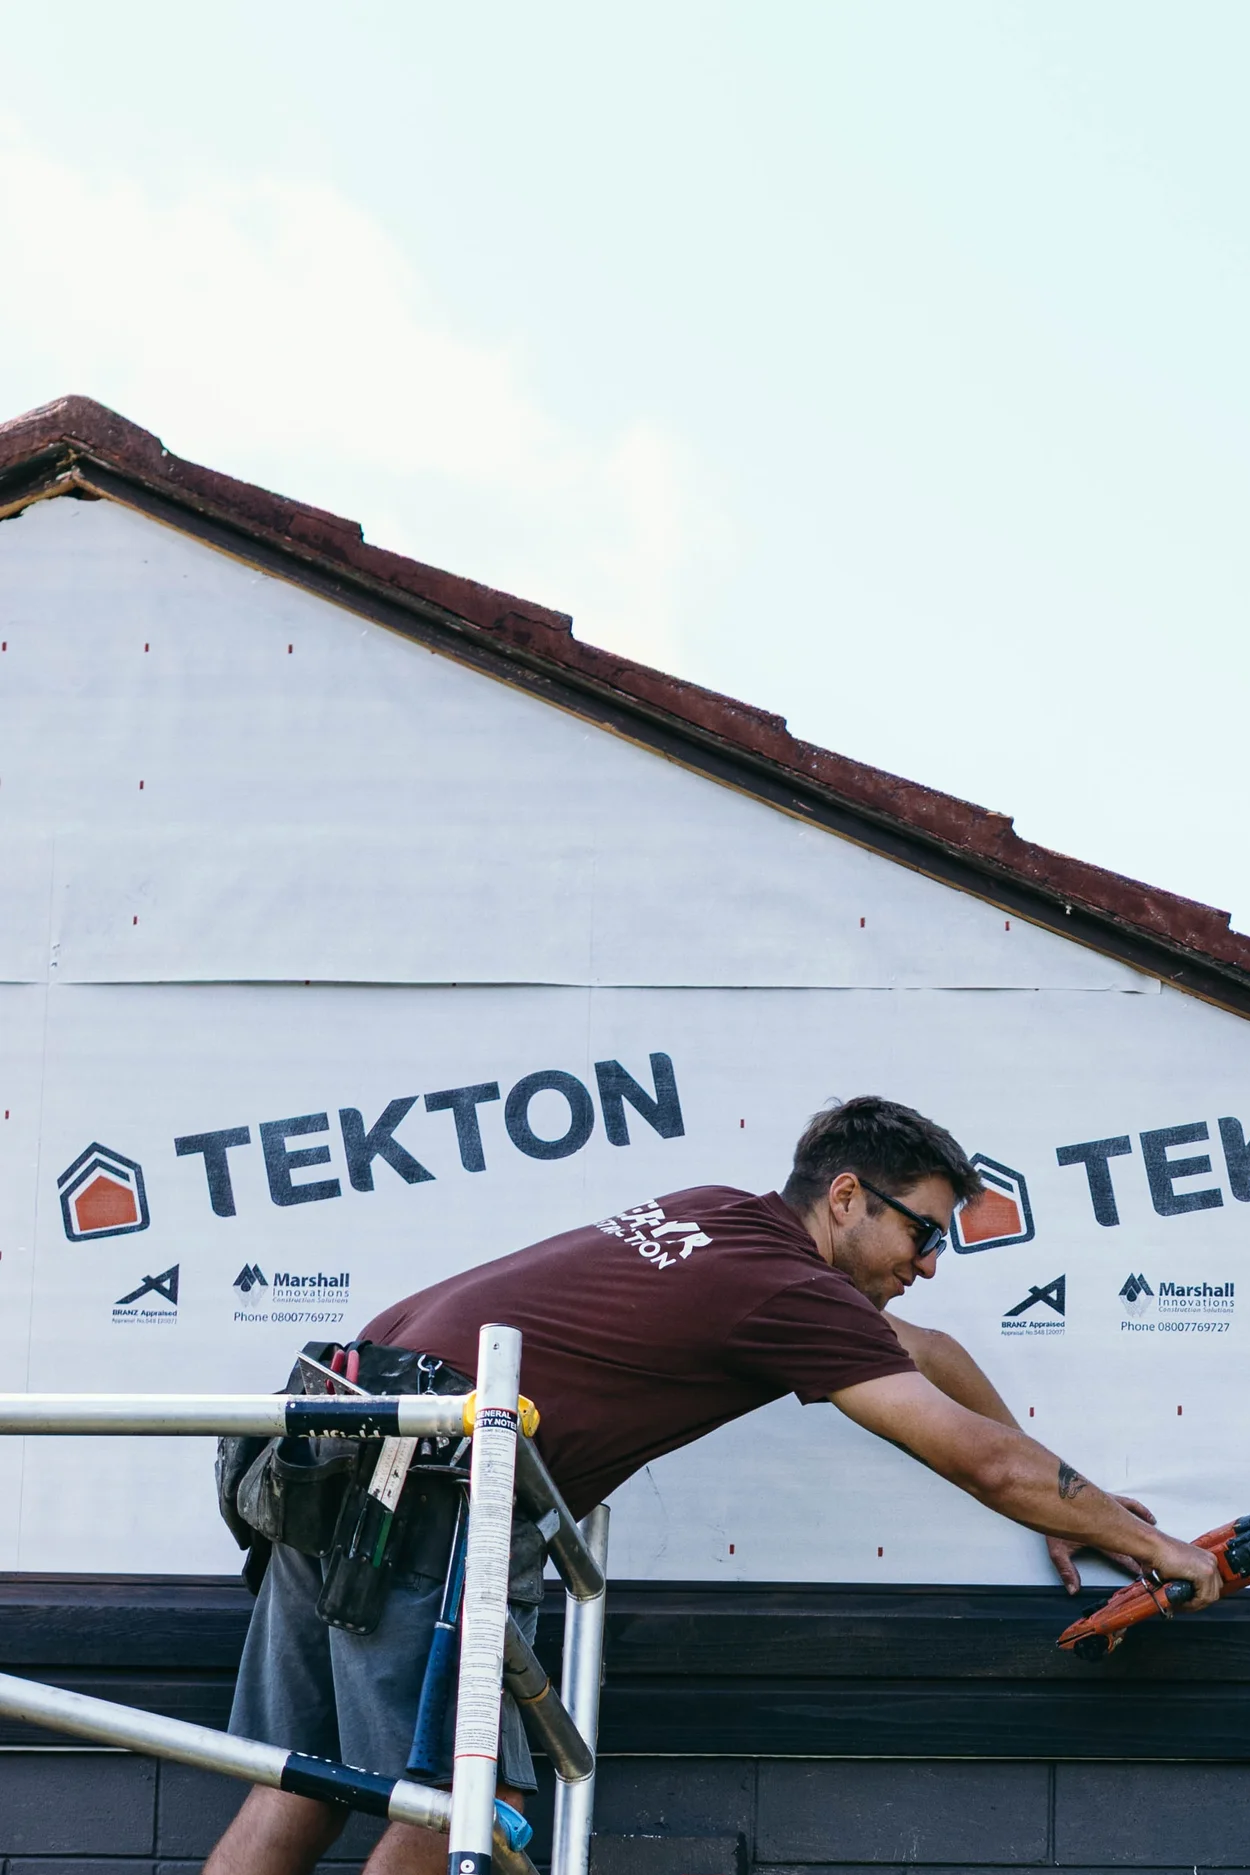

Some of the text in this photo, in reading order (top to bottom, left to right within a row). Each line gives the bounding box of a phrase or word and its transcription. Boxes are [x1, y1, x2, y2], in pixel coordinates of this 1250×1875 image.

[175, 1052, 686, 1218] TEKTON
[273, 1273, 350, 1287] Marshall
[273, 1288, 350, 1297] Innovations
[1159, 1282, 1234, 1297] Marshall
[1158, 1298, 1235, 1307] Innovations
[141, 1310, 177, 1318] Appraised
[234, 1312, 344, 1322] Phone 08007769727
[1029, 1321, 1065, 1329] Appraised
[1121, 1322, 1230, 1332] Phone 08007769727
